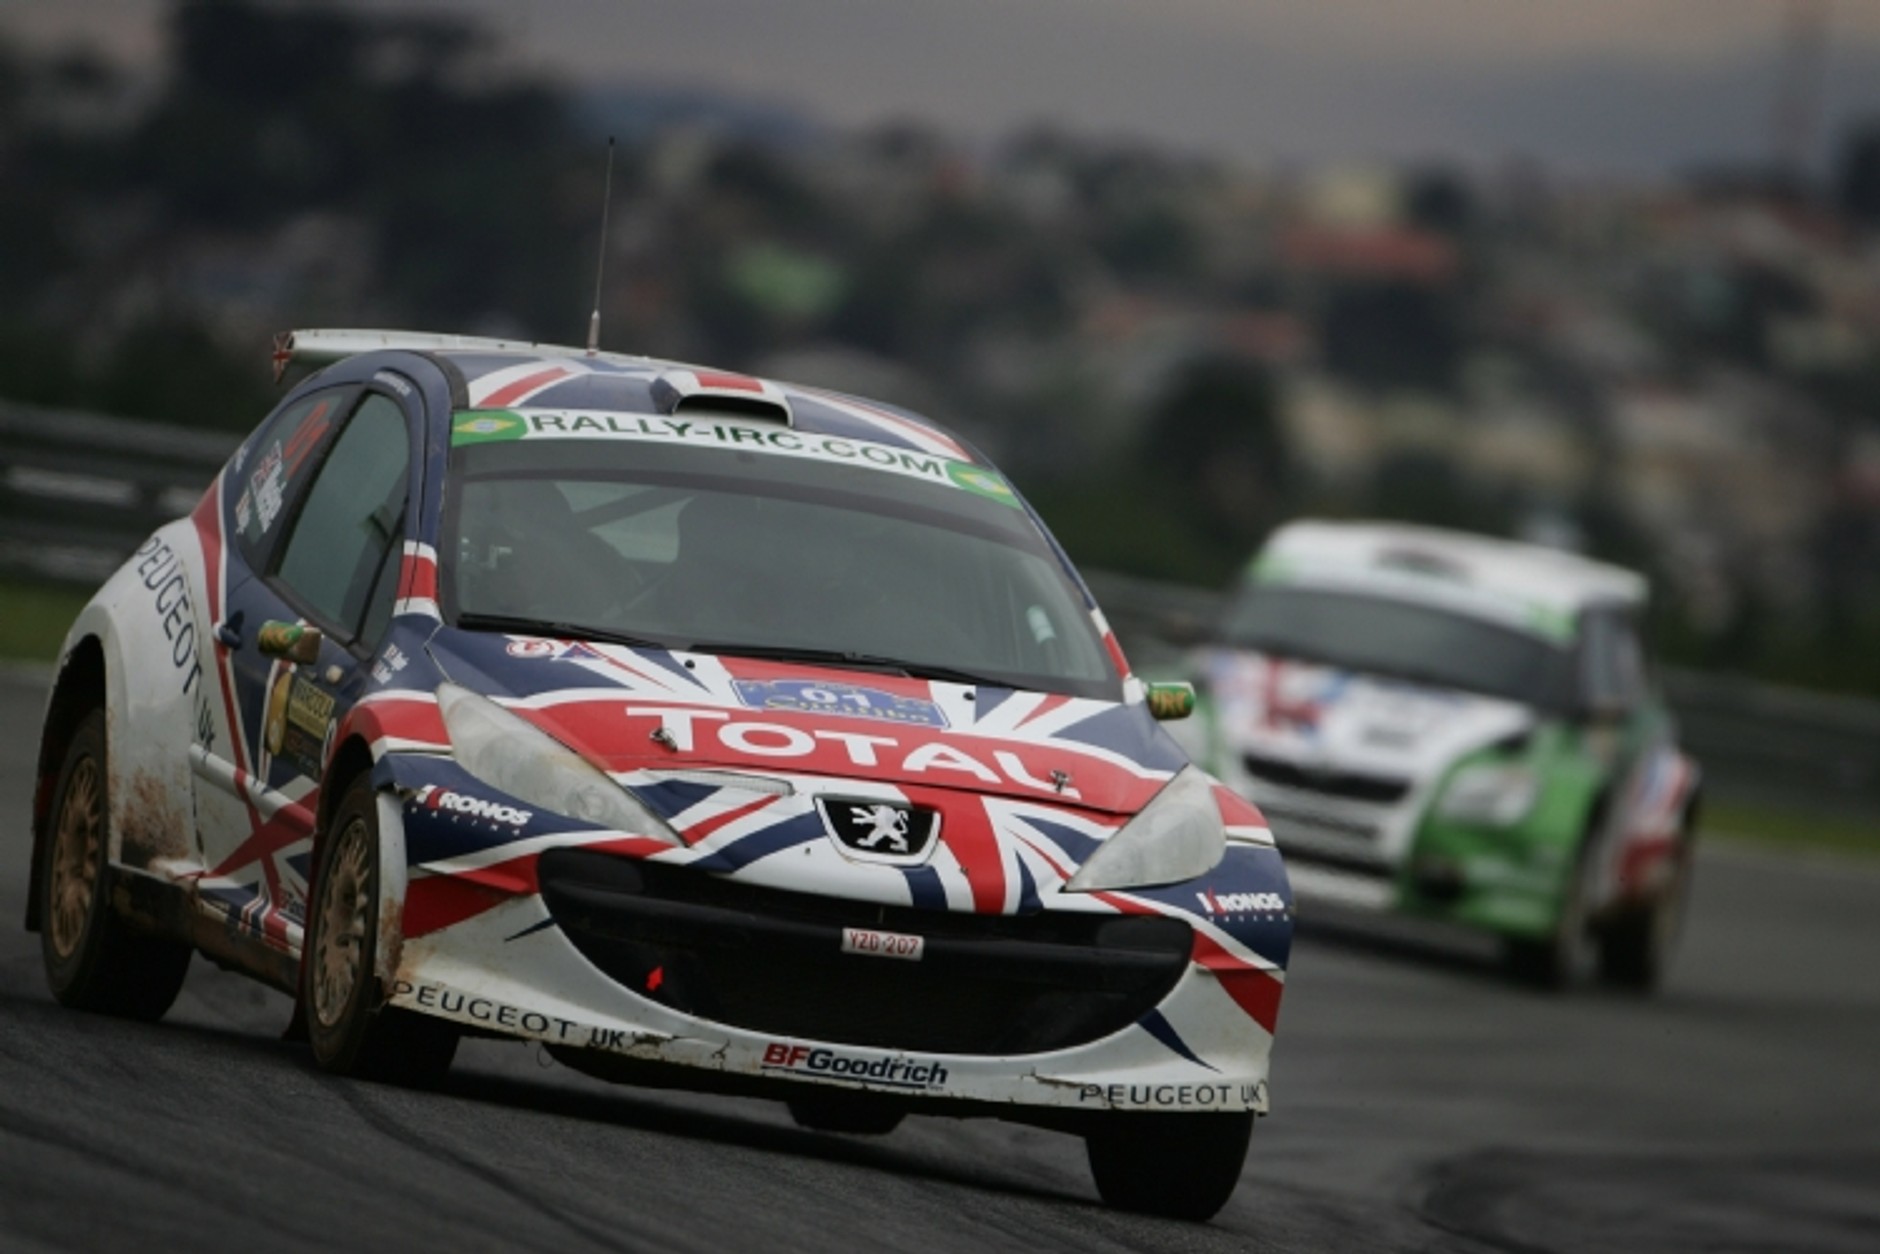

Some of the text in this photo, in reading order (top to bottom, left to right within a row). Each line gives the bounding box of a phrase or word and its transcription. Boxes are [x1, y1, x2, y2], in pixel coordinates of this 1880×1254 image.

[530, 414, 944, 477] RALLY-IRC.COM
[136, 536, 203, 695] PEUGEOT
[625, 706, 1082, 800] TOTAL
[416, 784, 533, 826] KRONOS
[1195, 886, 1285, 916] KRONOS
[392, 980, 625, 1049] PEUGEOT UK
[762, 1042, 949, 1085] BFGoodrich
[1080, 1085, 1232, 1106] PEUGEOT
